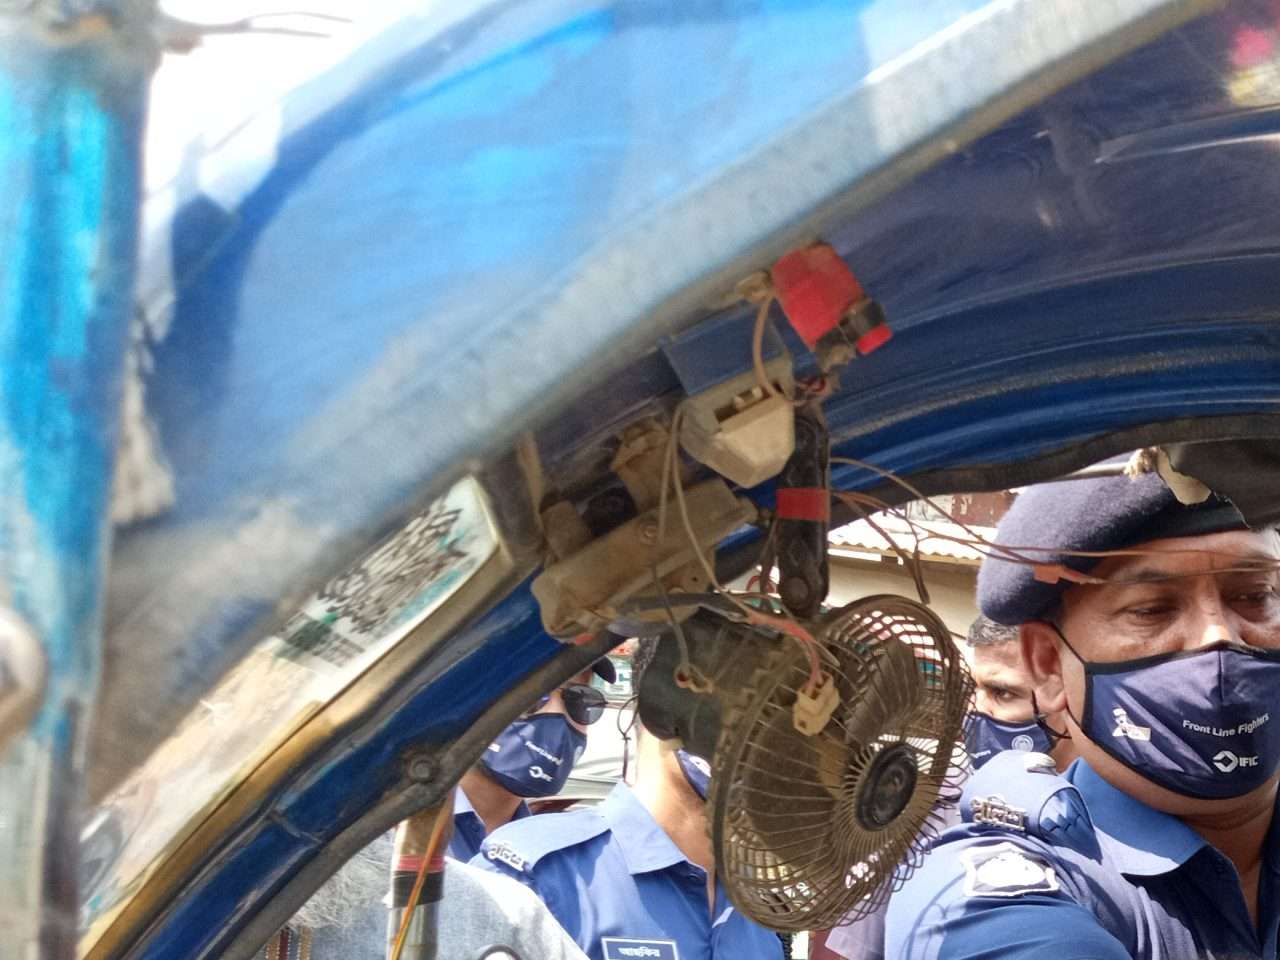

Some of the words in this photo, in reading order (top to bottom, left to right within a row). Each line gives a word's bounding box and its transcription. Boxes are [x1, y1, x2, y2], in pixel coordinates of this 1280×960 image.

[1182, 719, 1211, 735] Front
[1212, 726, 1236, 738] Line
[1237, 711, 1269, 735] Fighters
